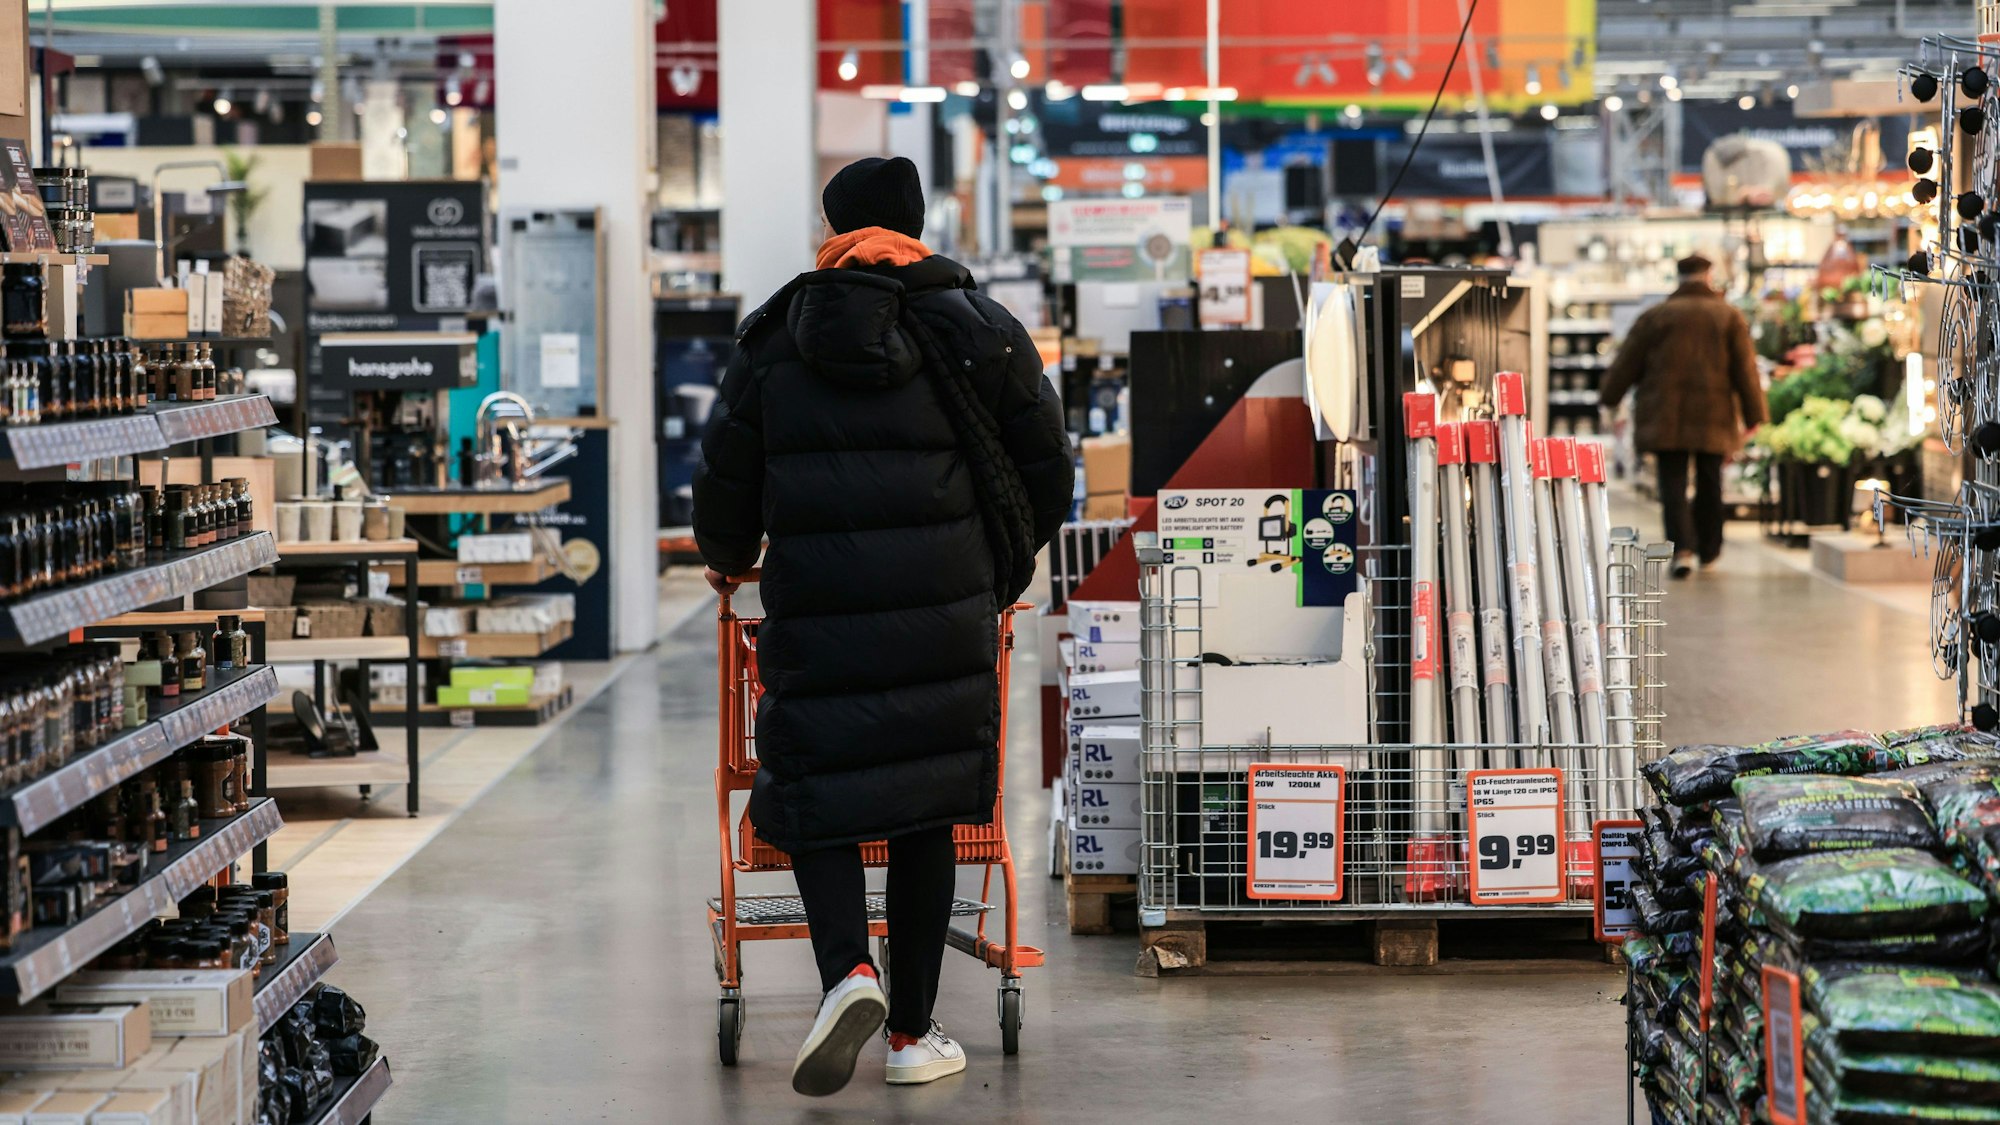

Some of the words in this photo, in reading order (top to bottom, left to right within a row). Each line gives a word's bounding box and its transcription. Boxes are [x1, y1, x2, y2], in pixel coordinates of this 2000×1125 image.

[349, 356, 433, 379] hansgrohe
[1166, 496, 1188, 508] REV
[1195, 497, 1227, 507] SPOT
[1230, 497, 1245, 507] 20
[1080, 646, 1096, 657] RL
[1072, 688, 1091, 700] RL
[1085, 744, 1112, 762] RL
[1255, 770, 1314, 778] Arbeitsleuchte
[1473, 777, 1557, 786] LED-Feuchtraumleuchte
[1082, 789, 1109, 807] RL
[1076, 835, 1103, 853] RL
[1257, 831, 1334, 859] 19,99
[1479, 834, 1555, 870] 9,99
